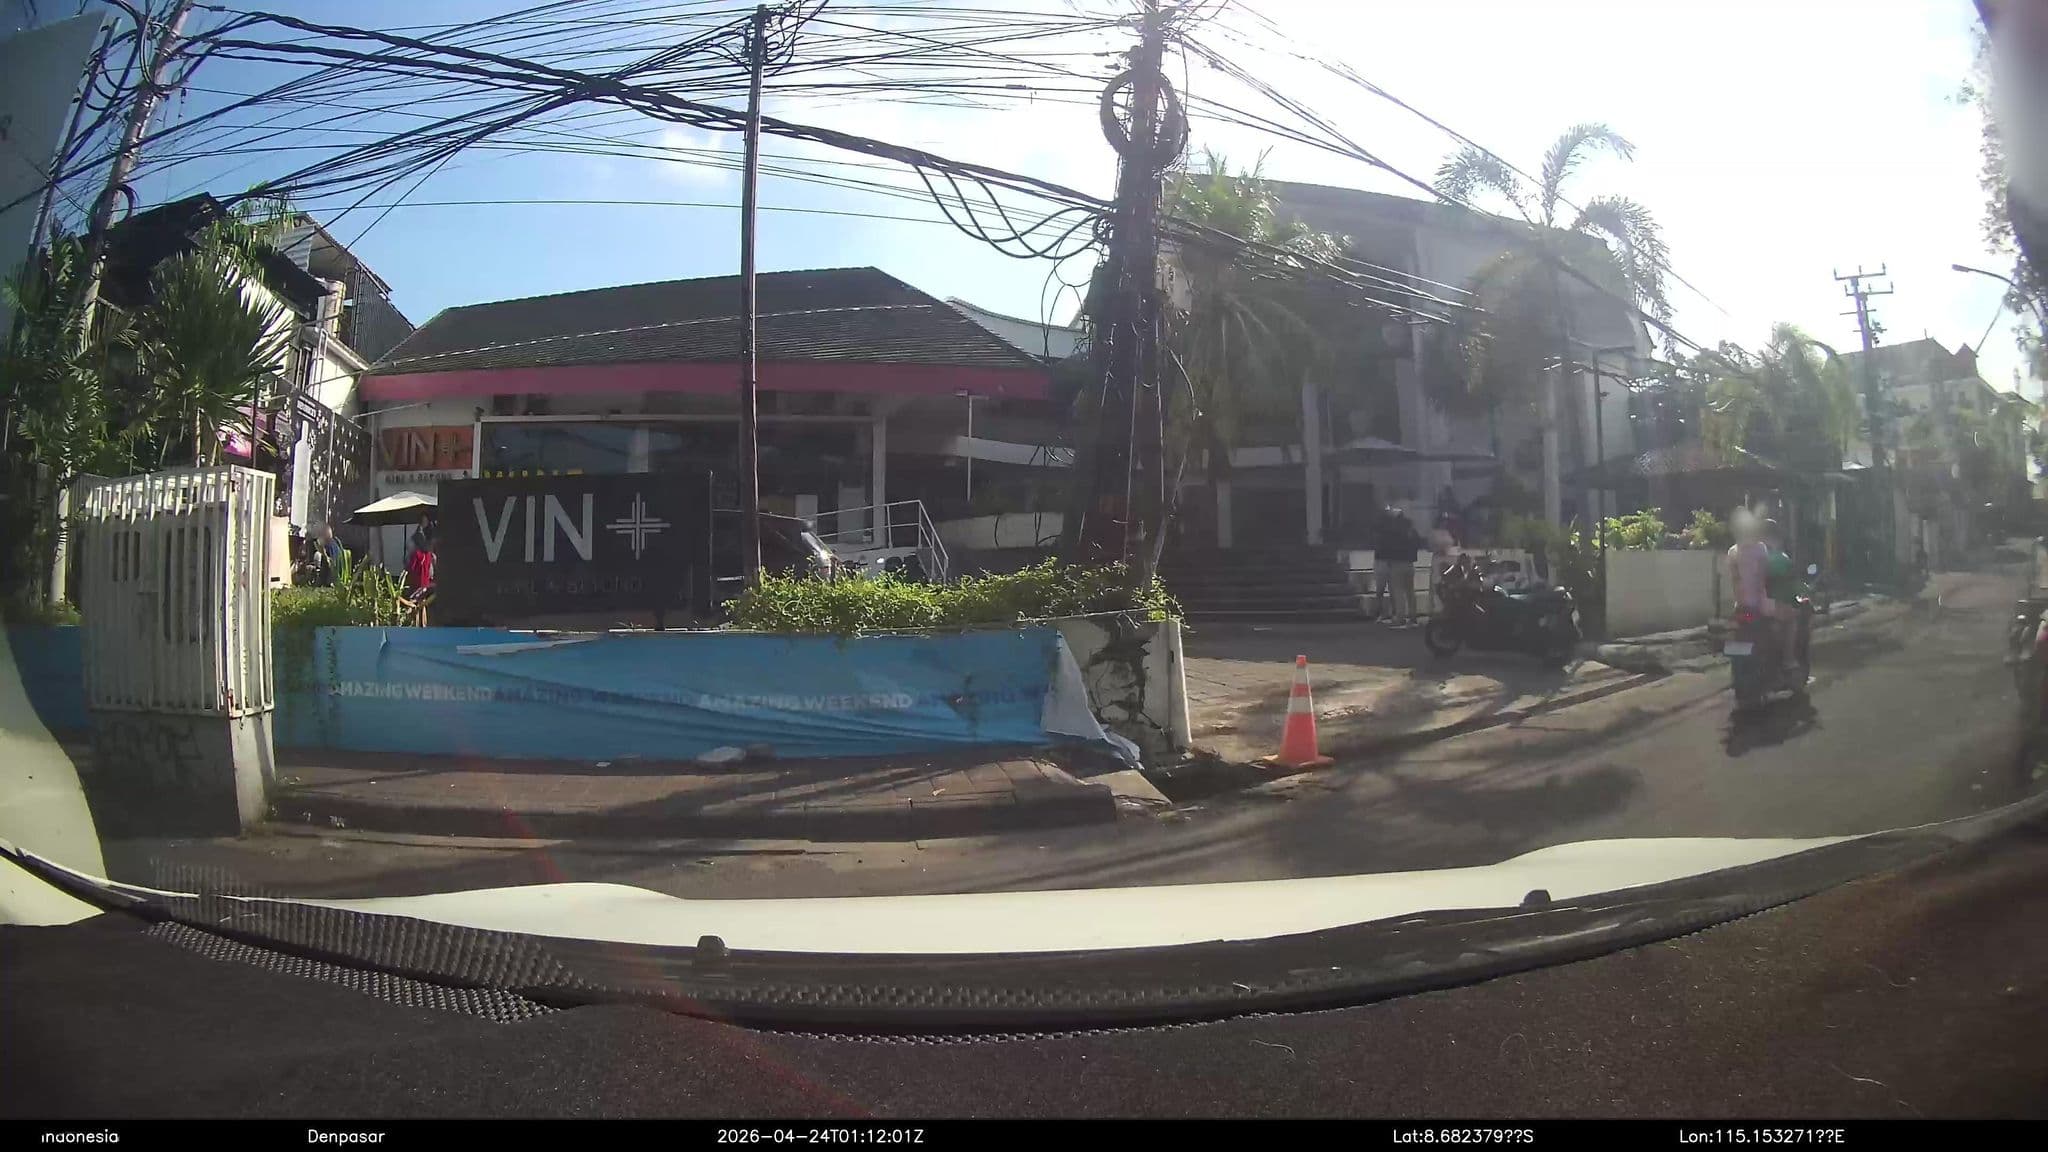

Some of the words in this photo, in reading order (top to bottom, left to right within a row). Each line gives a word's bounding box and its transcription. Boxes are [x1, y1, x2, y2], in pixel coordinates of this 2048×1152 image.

[472, 493, 594, 563] VIN
[405, 682, 493, 703] WEEKEND
[804, 693, 913, 711] WEEKEND
